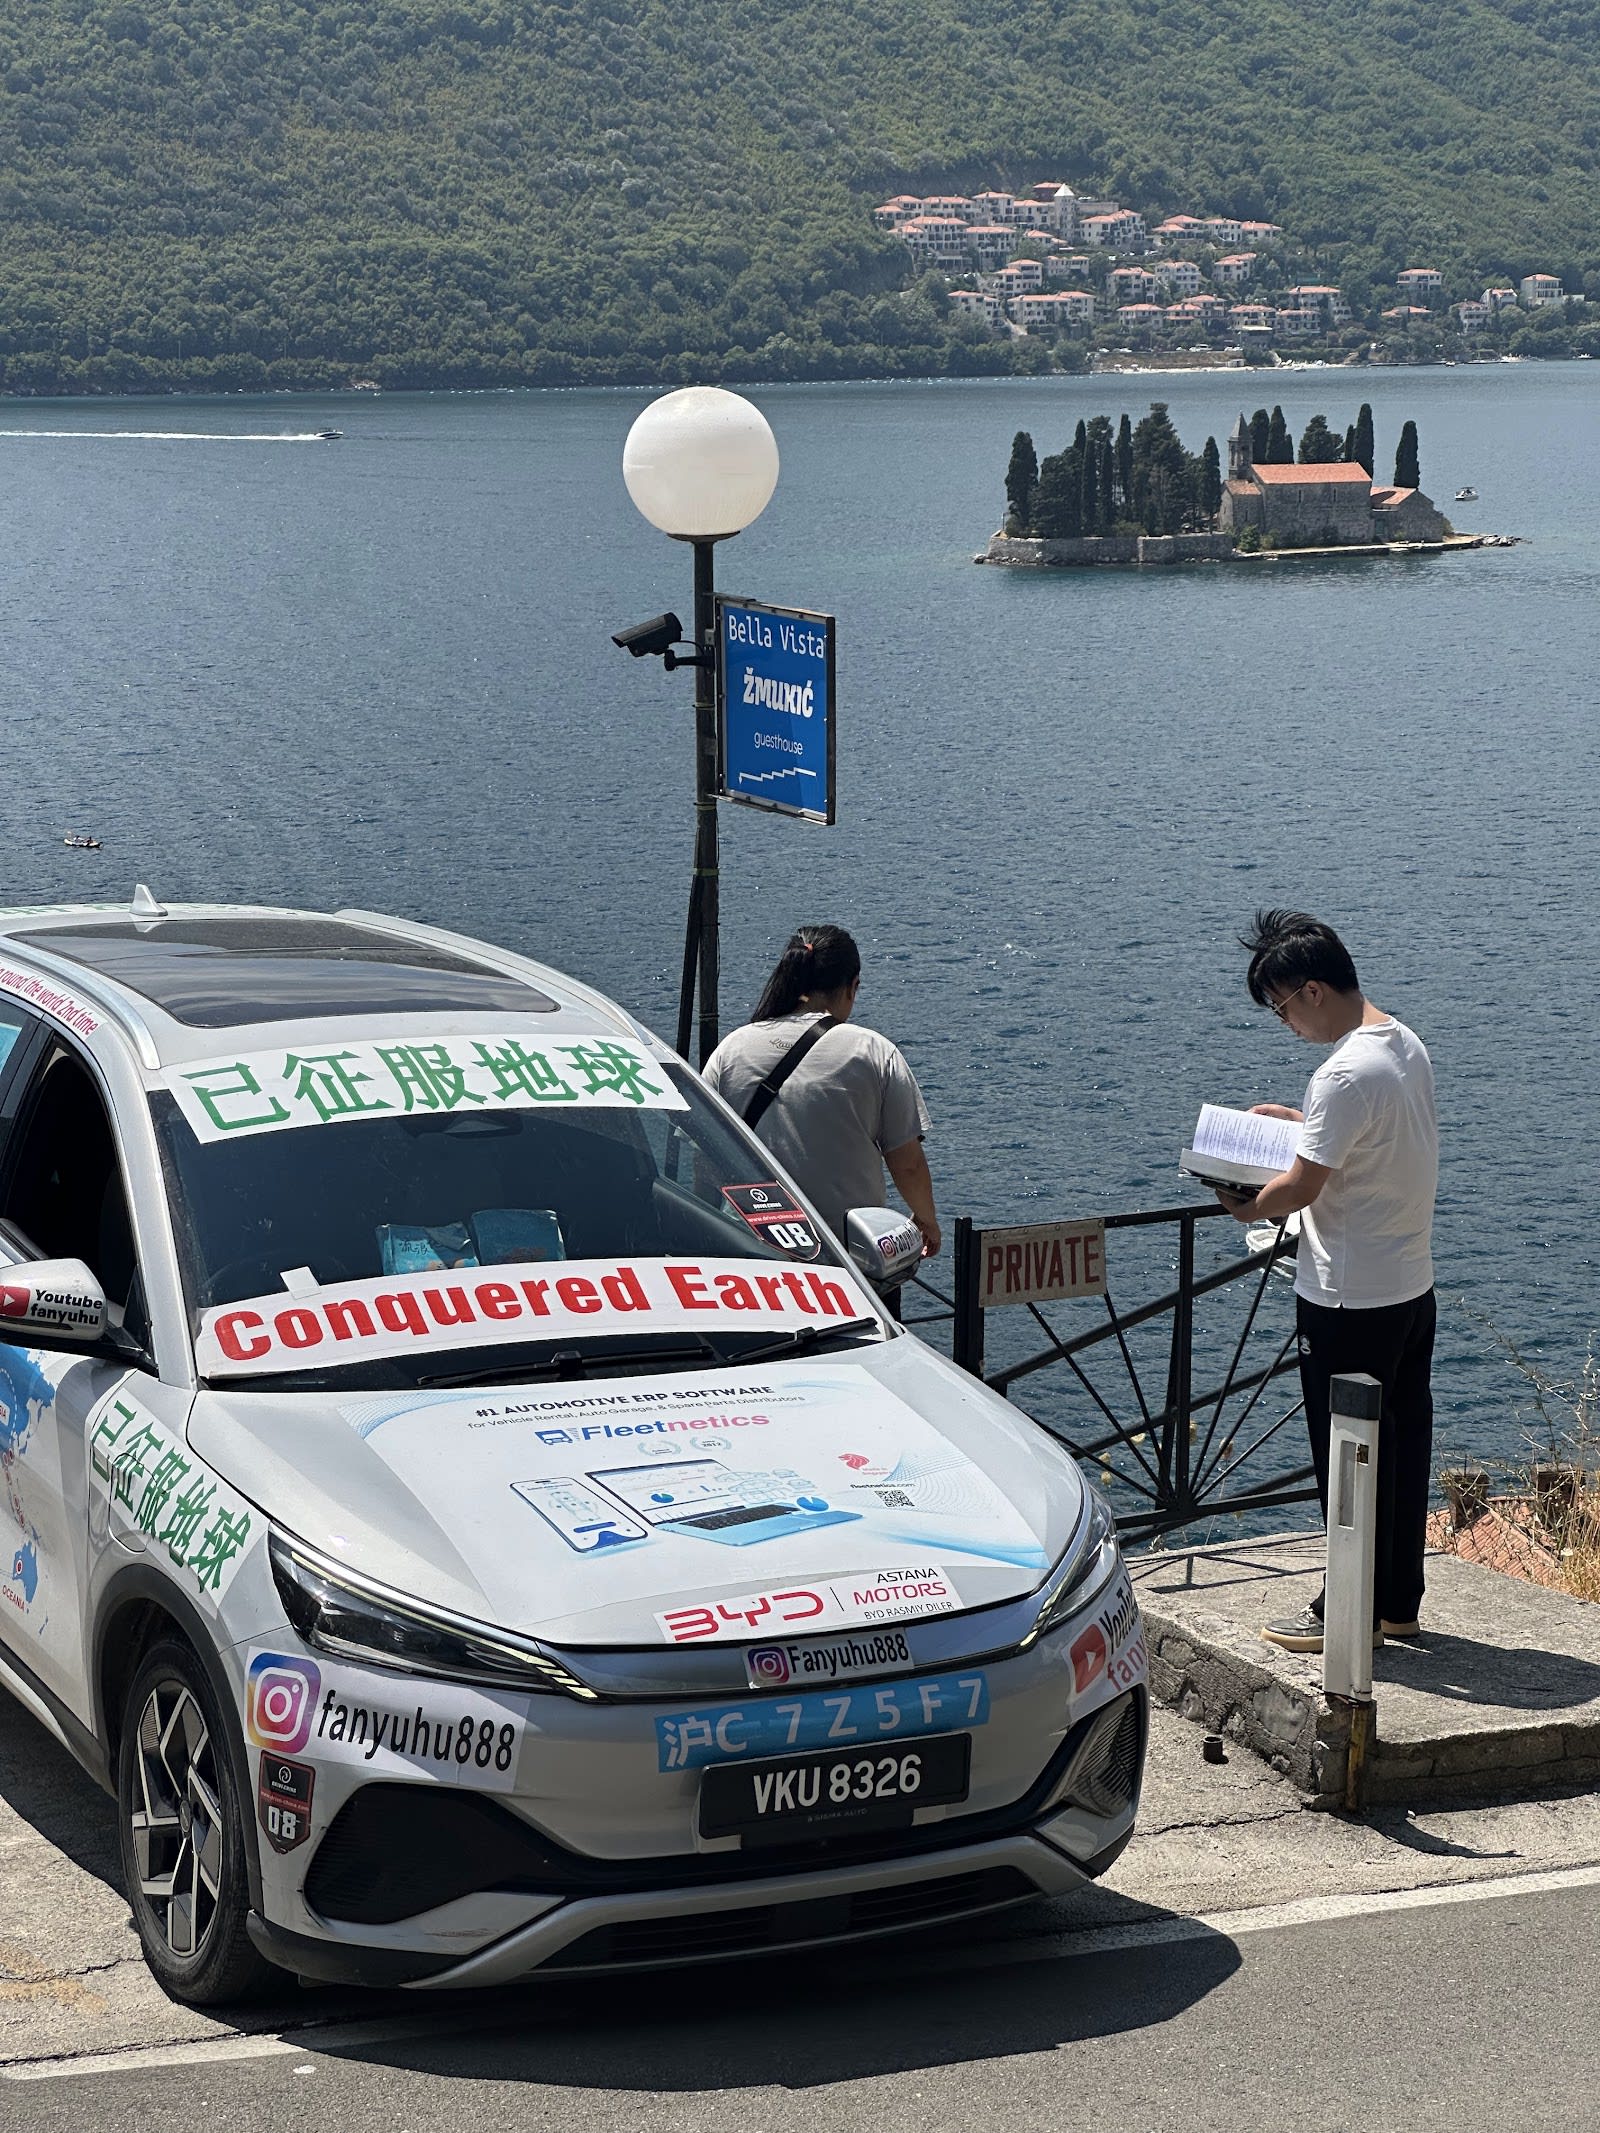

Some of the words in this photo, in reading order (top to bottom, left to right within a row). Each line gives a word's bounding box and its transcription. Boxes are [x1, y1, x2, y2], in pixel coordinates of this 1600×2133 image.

[729, 615, 772, 648] Bella
[779, 624, 825, 659] Vista
[753, 730, 803, 756] guesthouse
[24, 979, 44, 997] the
[36, 989, 70, 1011] world
[57, 1001, 85, 1022] 2nd
[73, 1010, 98, 1035] time
[767, 1222, 815, 1249] 08
[986, 1234, 1100, 1296] PRIVATE
[30, 1303, 99, 1325] fanyuhu
[35, 1289, 103, 1310] Youtube
[214, 1266, 652, 1361] Conquered
[663, 1266, 858, 1318] Earth
[467, 1422, 486, 1430] for
[487, 1416, 533, 1426] Vehicle
[534, 1411, 578, 1421] Rental,
[579, 1409, 607, 1418] Auto
[608, 1403, 657, 1413] Garage,
[667, 1401, 703, 1411] Spare
[704, 1399, 736, 1407] Parts
[737, 1395, 805, 1405] Distributors
[476, 1408, 499, 1418] #1
[504, 1396, 630, 1415] AUTOMOTIVE
[632, 1393, 668, 1403] ERP
[672, 1386, 775, 1400] SOFTWARE
[581, 1415, 770, 1441] Fleetnetics
[876, 1567, 938, 1584] ASTANA
[3, 1584, 25, 1611] OCEANIA
[853, 1581, 947, 1606] MOTORS
[664, 1590, 824, 1641] BYD
[864, 1609, 884, 1620] BYD
[886, 1604, 925, 1618] RASMIY
[927, 1601, 954, 1613] DILER
[789, 1633, 909, 1676] Fanyuhu888
[317, 1689, 515, 1772] fanyuhu888
[753, 1766, 821, 1814] VKU
[829, 1754, 922, 1802] 8326
[267, 1805, 297, 1840] 08
